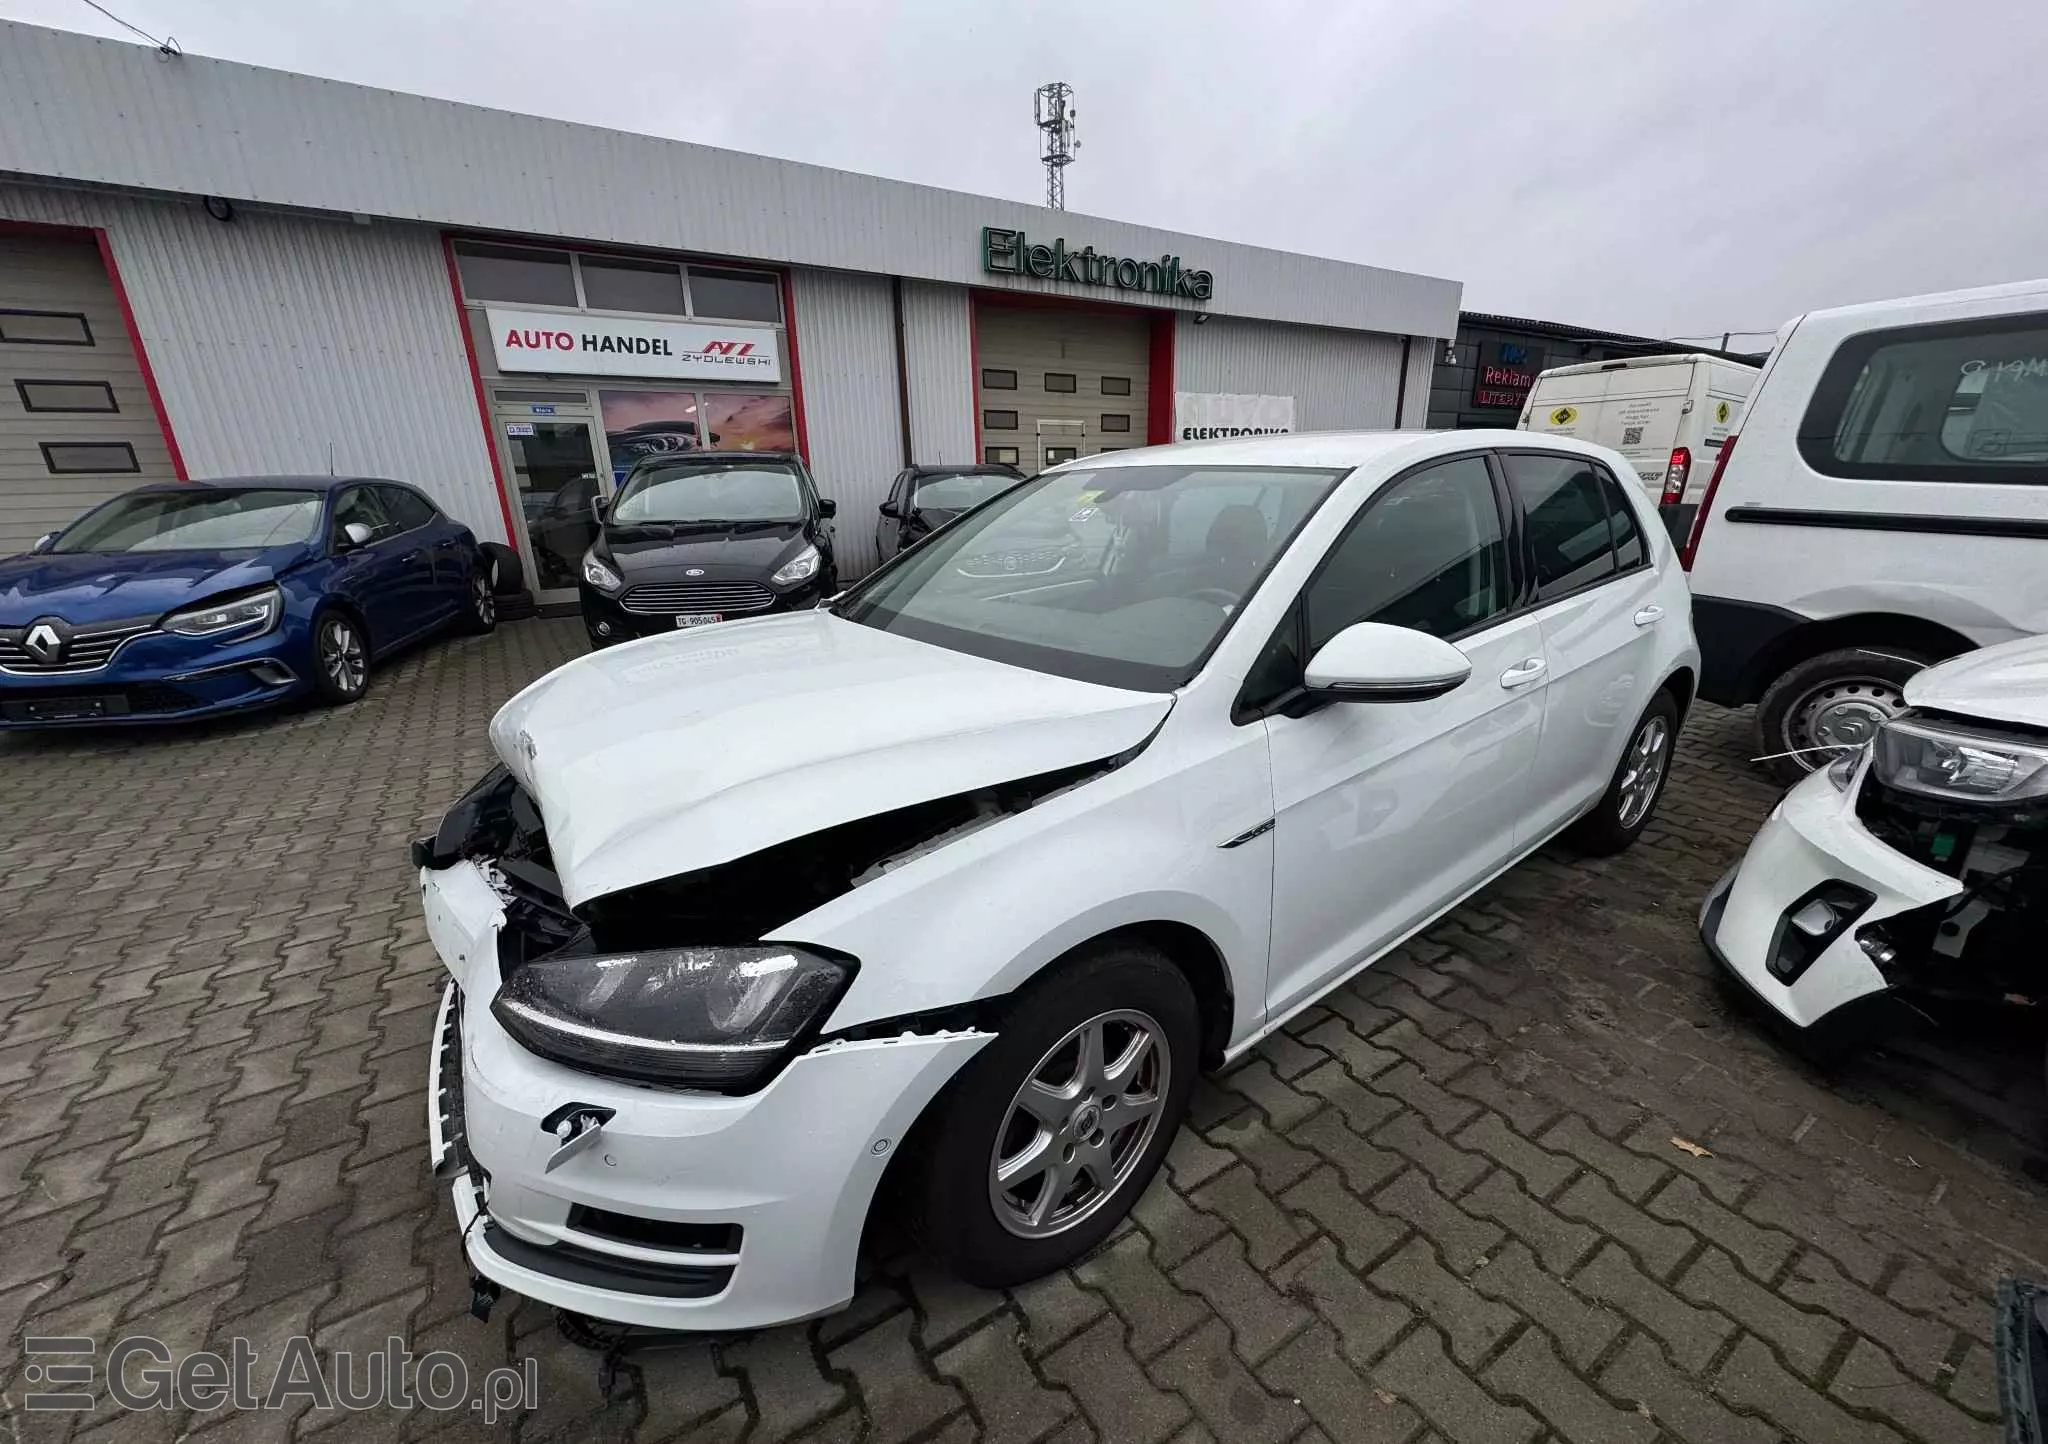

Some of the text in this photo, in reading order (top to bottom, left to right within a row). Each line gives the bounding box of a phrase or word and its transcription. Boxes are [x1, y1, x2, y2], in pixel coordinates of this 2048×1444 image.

[982, 227, 1214, 300] Elektronika
[506, 329, 673, 356] AUTO HANDEL
